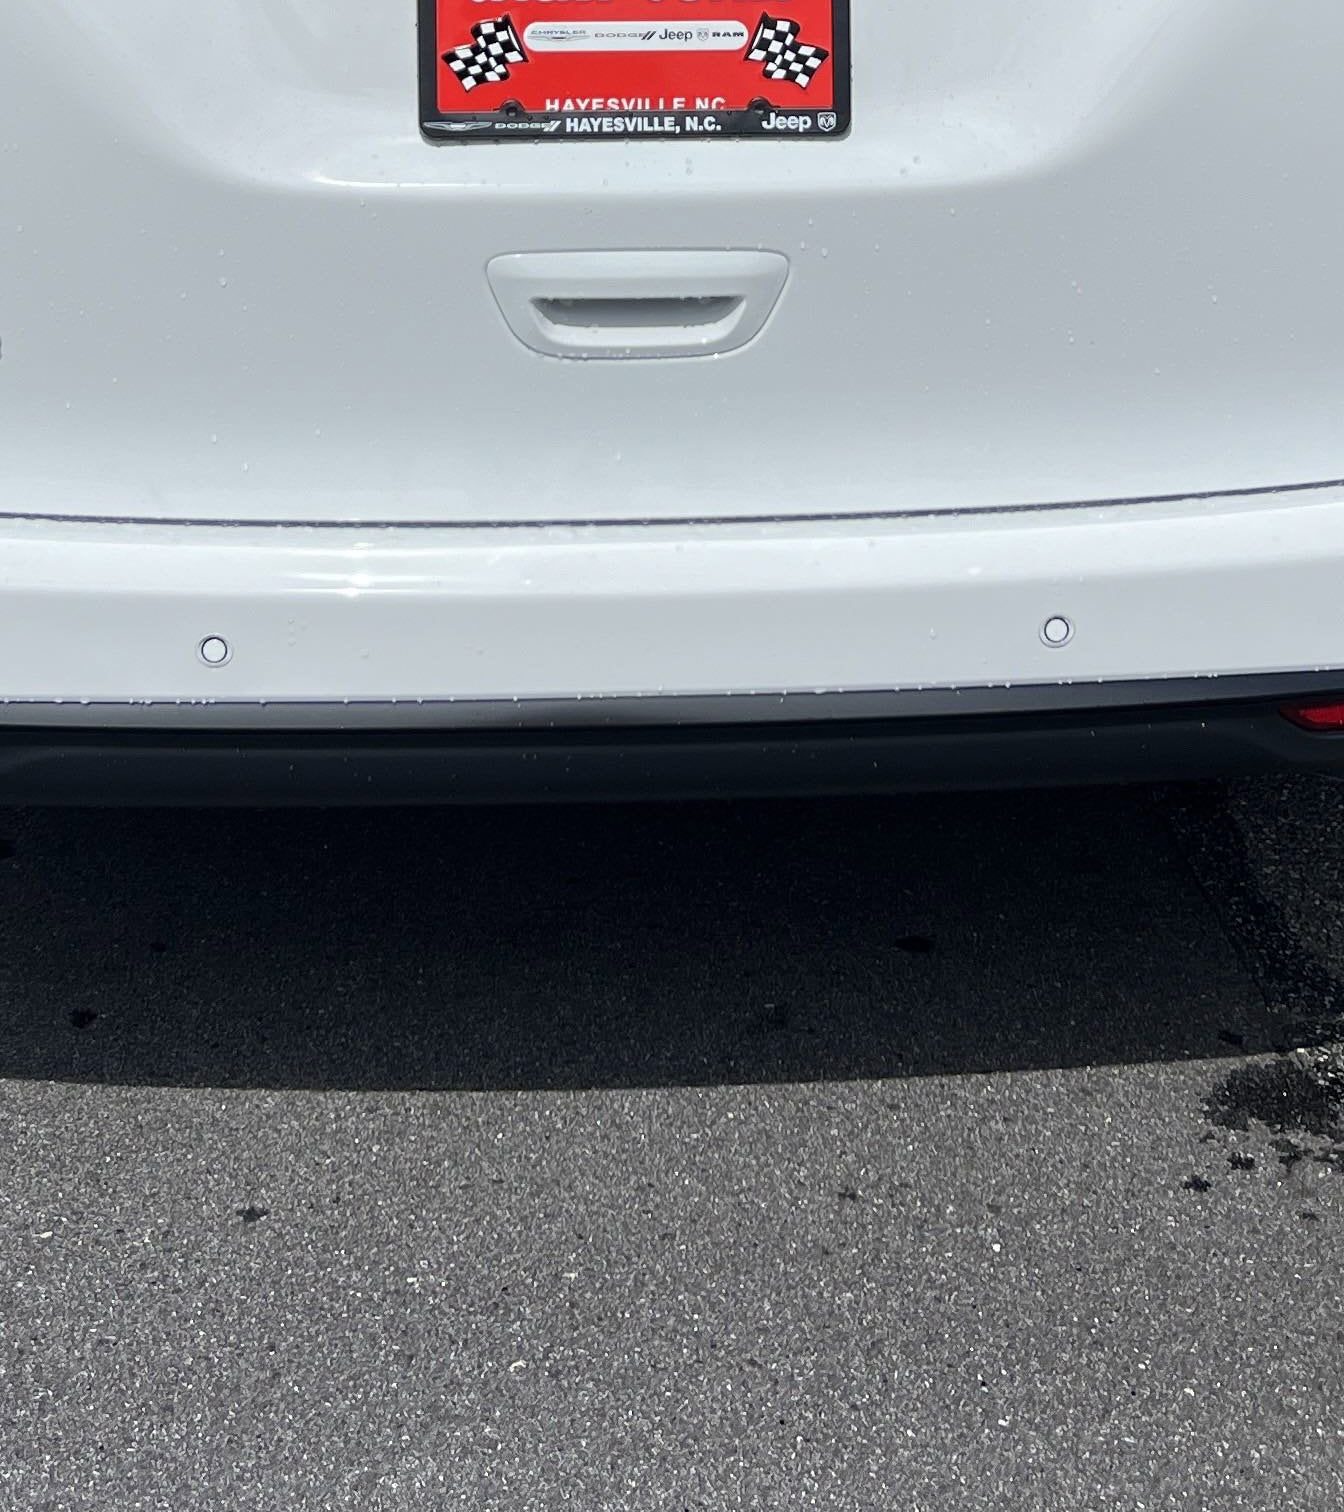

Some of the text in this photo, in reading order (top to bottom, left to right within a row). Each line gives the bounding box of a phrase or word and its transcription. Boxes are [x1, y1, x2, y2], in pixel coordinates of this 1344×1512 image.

[659, 28, 693, 42] Jeep
[566, 117, 680, 134] HAYESVILLE,
[685, 116, 722, 132] N.C.
[762, 112, 812, 131] Jeep
